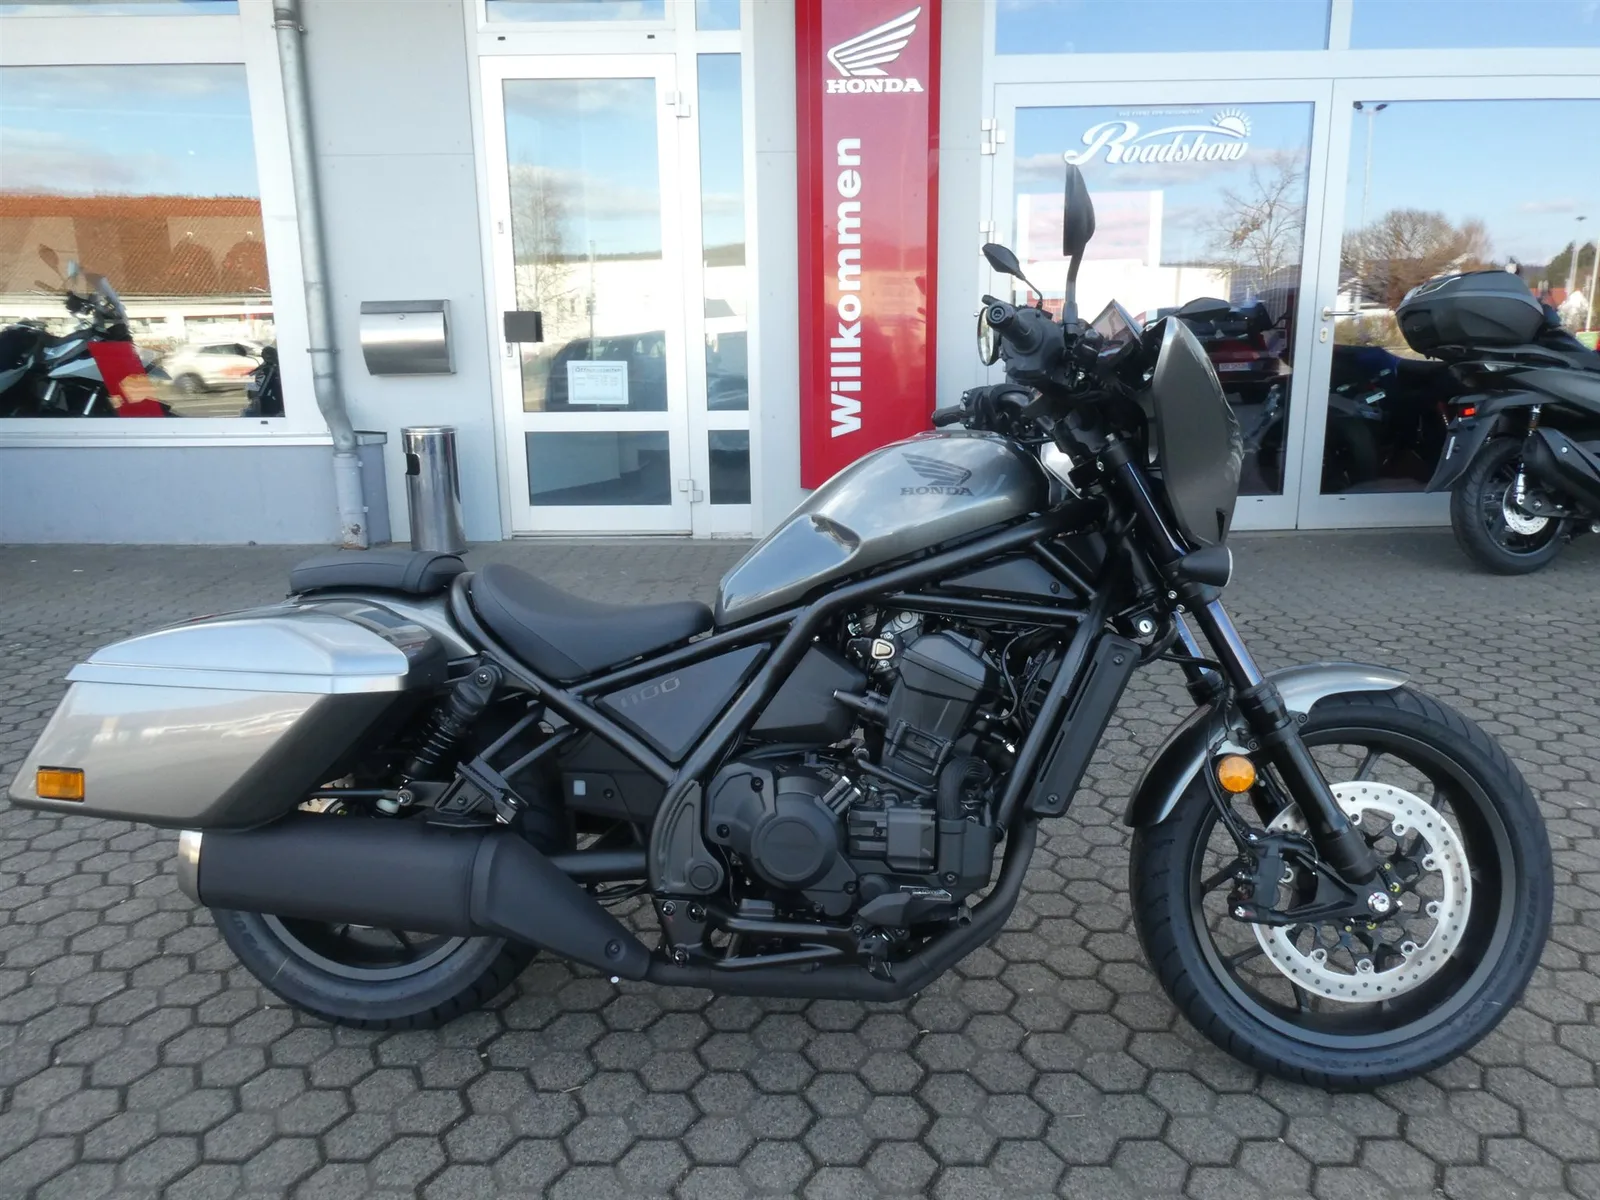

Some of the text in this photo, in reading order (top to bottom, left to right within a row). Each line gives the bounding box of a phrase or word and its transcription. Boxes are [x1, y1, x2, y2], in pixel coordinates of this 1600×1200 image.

[826, 78, 924, 93] HONDA
[1064, 120, 1249, 165] Roadshow
[830, 138, 861, 438] Willkommen
[900, 486, 974, 496] HONDA
[621, 677, 680, 708] 1100
